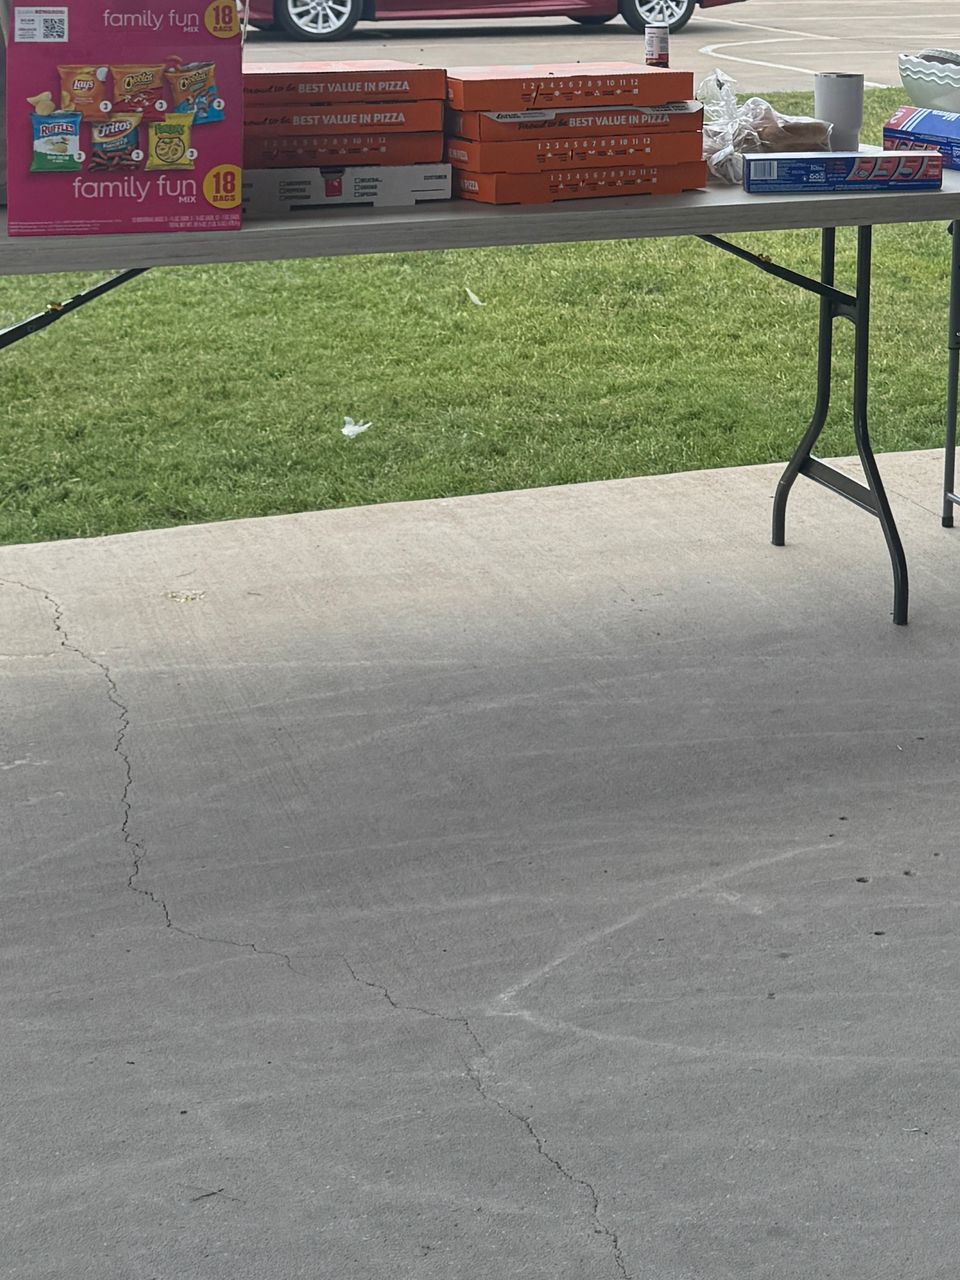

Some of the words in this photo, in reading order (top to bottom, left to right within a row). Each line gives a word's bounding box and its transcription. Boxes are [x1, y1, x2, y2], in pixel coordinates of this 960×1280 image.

[102, 9, 164, 31] family
[168, 9, 200, 26] fun
[212, 5, 233, 25] 18
[298, 83, 324, 94] BEST
[327, 82, 362, 92] VALUE
[364, 82, 376, 92] IN
[378, 80, 410, 91] PIZZA
[293, 115, 320, 125] BEST
[322, 114, 357, 124] VALUE
[359, 114, 371, 124] IN
[373, 112, 406, 123] PIZZA
[568, 116, 594, 128] BEST
[595, 115, 627, 126] VALUE
[628, 114, 640, 125] IN
[641, 114, 670, 124] PIZZA
[97, 120, 132, 136] Fritos
[72, 176, 151, 203] family
[157, 174, 196, 196] fun
[212, 171, 236, 194] 18
[178, 196, 197, 204] MIX
[212, 194, 236, 203] BAGS
